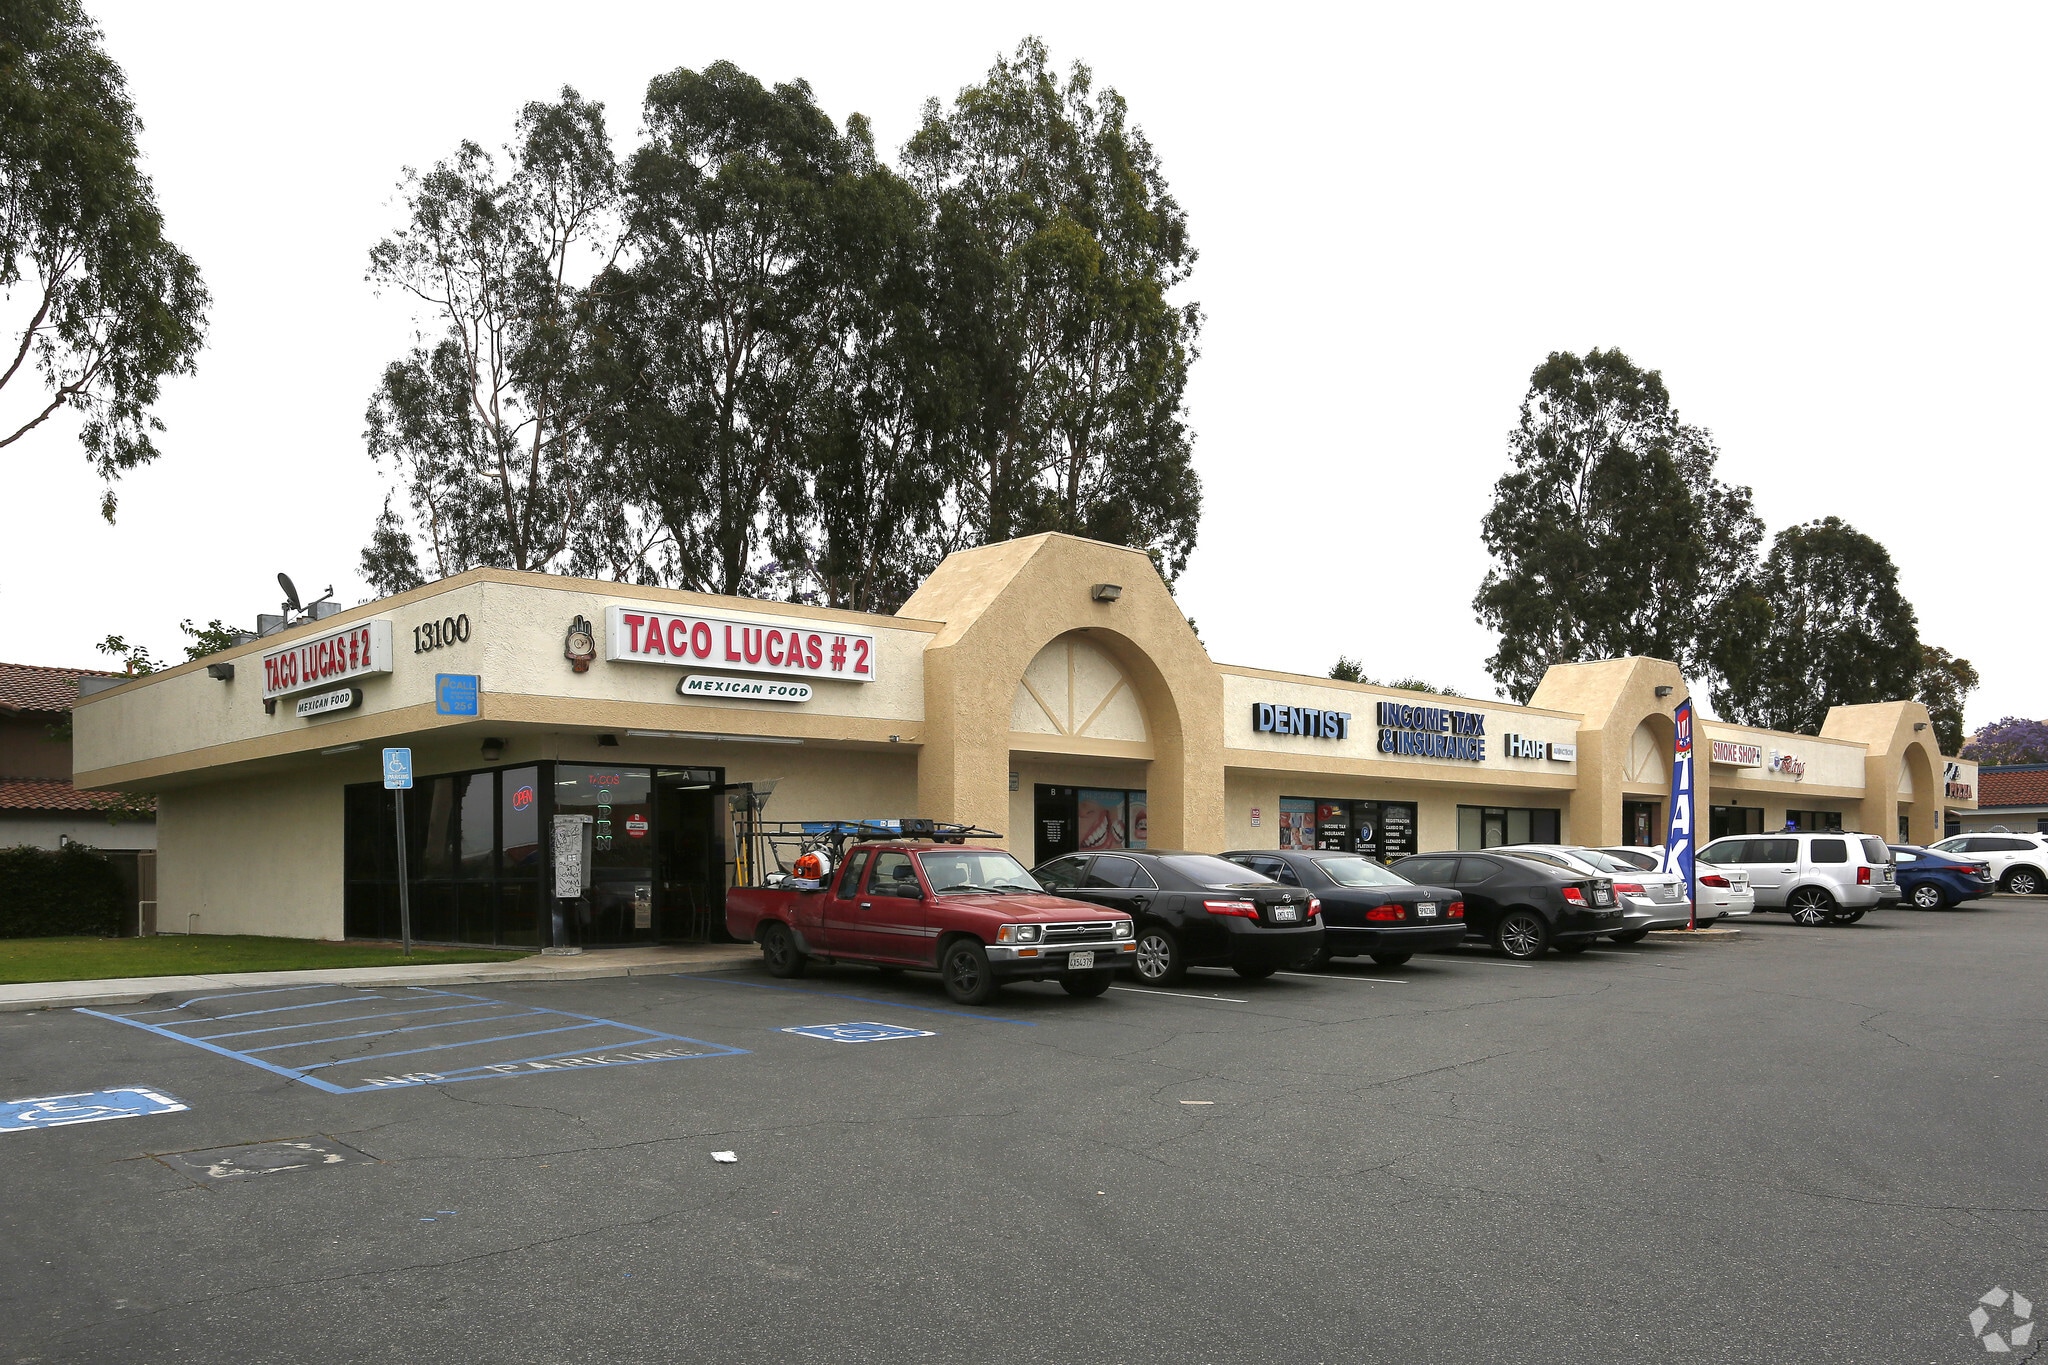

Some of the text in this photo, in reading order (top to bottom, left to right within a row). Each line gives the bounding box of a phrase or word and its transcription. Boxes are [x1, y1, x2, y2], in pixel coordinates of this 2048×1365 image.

[412, 613, 471, 654] 13100
[624, 613, 713, 659] TACO
[724, 625, 824, 670] LUCAS
[264, 651, 298, 692] TACO
[302, 636, 346, 682] LUCAS
[448, 681, 476, 691] CALL
[687, 680, 809, 698] MEXICAN FOOD
[297, 692, 350, 713] MEXICAN FOOD
[1257, 702, 1352, 740] DENTIST
[1381, 701, 1486, 736] INCOME TAX
[1381, 728, 1486, 761] & INSURANCE
[1713, 742, 1737, 762] SMOKE
[1738, 745, 1756, 764] SHOP
[588, 774, 621, 786] TACOS
[681, 771, 690, 781] A
[512, 789, 534, 807] OPEN
[1050, 788, 1056, 796] B
[1949, 782, 1973, 799] PIZZA
[596, 789, 613, 851] OPEN
[360, 1048, 703, 1087] NO PARKING
